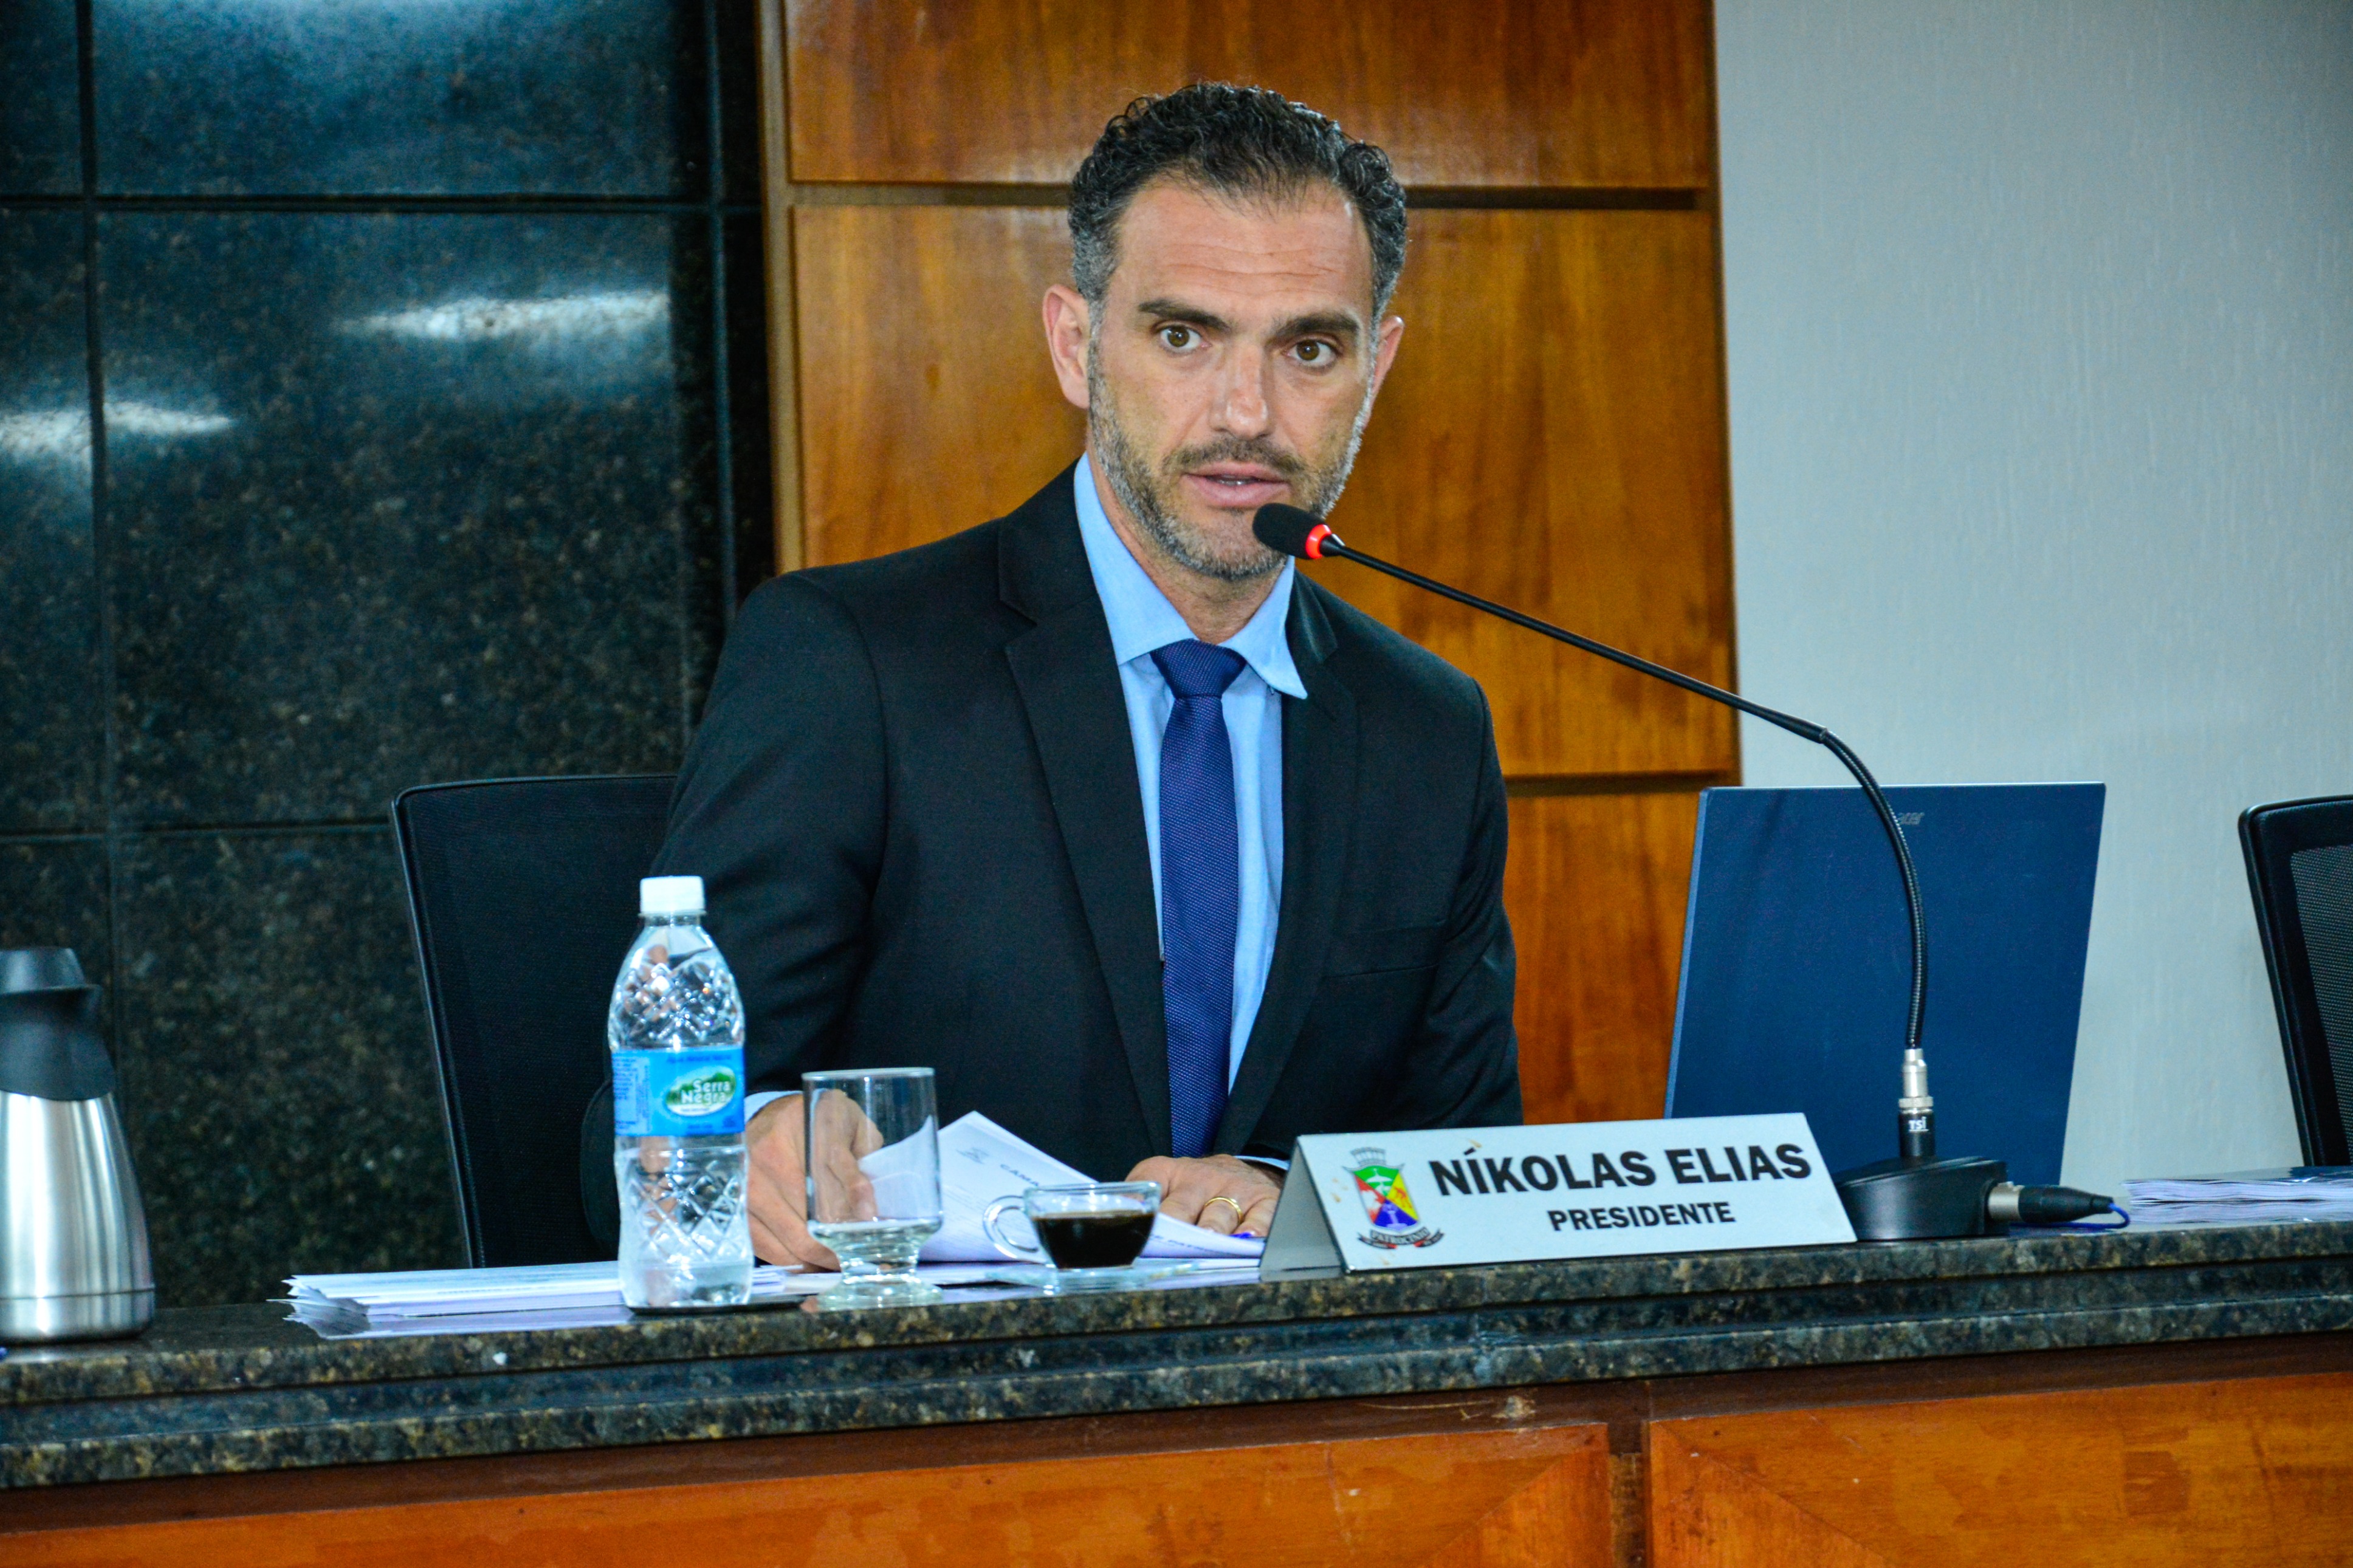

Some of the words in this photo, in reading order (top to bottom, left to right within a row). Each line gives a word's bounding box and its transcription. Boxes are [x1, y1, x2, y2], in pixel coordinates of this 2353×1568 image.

[693, 1079, 732, 1093] Serra
[681, 1090, 727, 1106] Negra
[1429, 1147, 1657, 1196] NÍKOLAS
[1664, 1143, 1812, 1185] ELIAS
[1547, 1200, 1736, 1231] PRESIDENTE
